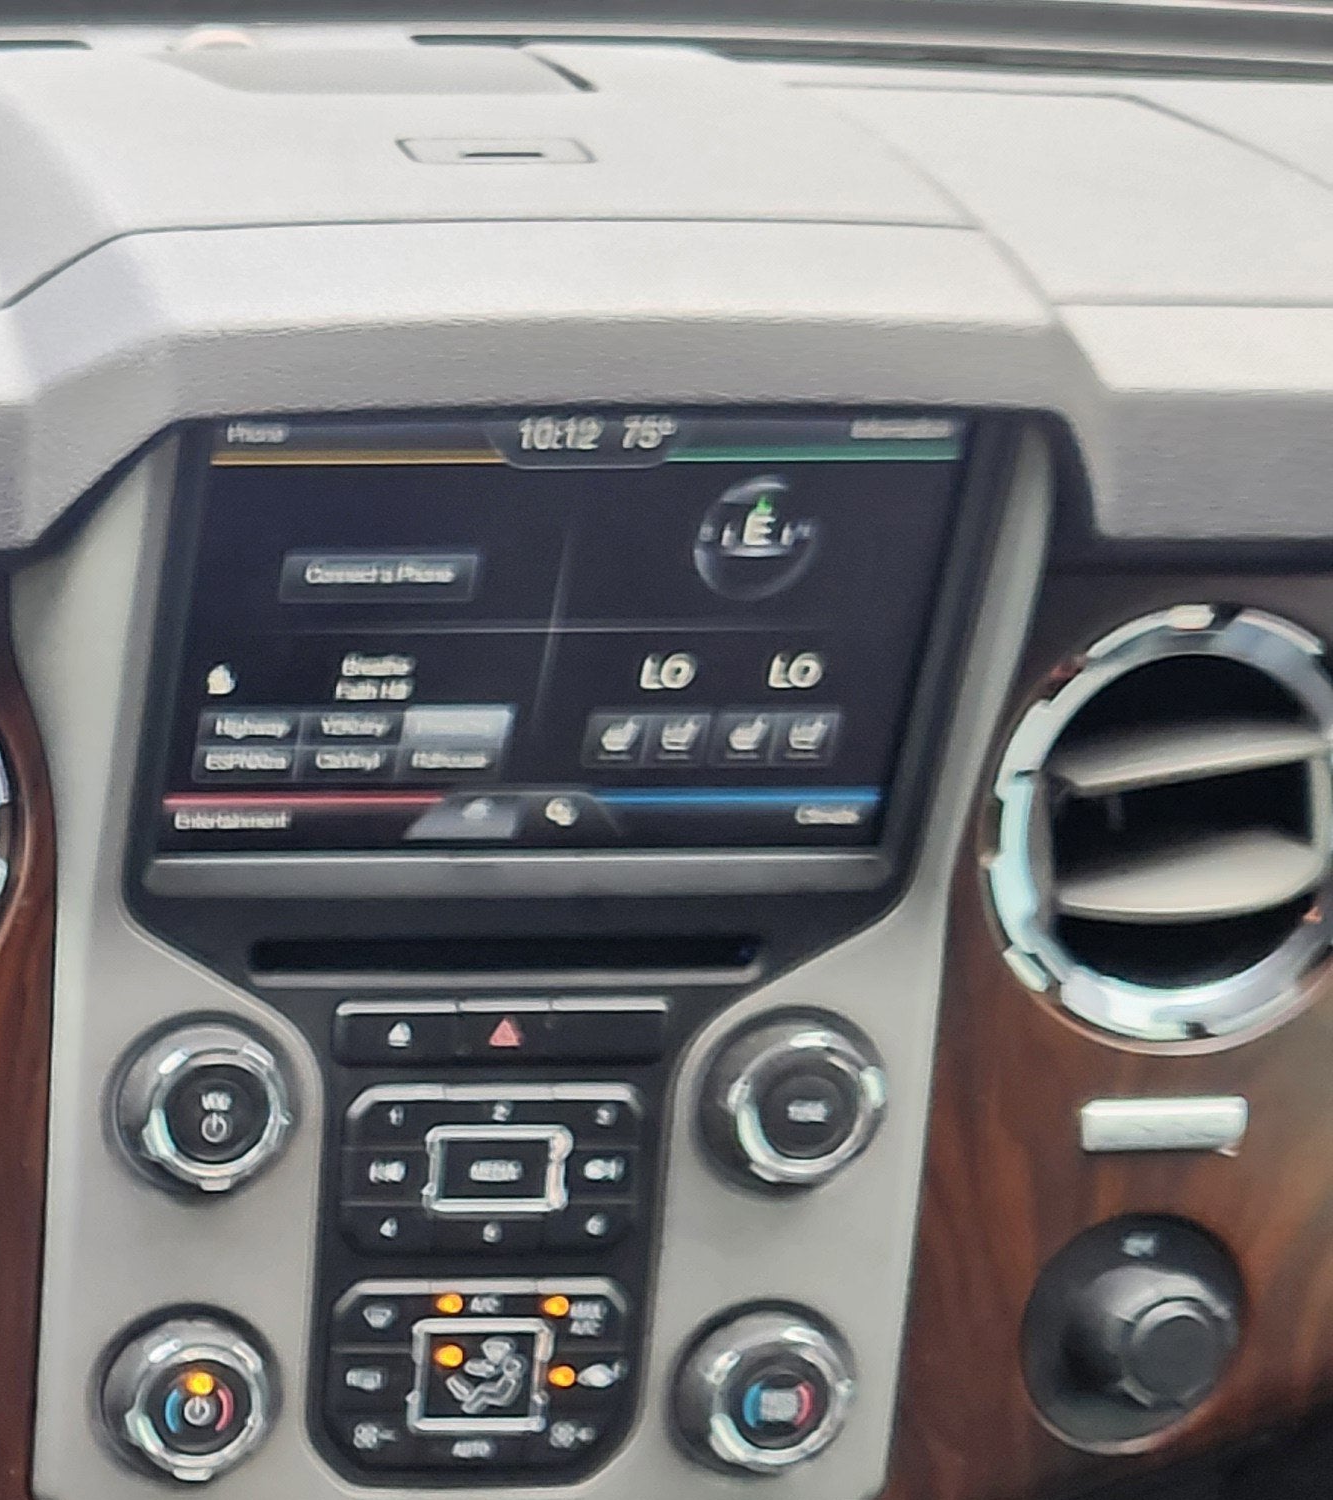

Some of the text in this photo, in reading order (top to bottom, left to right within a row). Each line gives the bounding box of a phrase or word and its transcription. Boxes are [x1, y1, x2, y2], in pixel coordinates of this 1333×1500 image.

[519, 418, 602, 450] 10:12
[640, 653, 696, 690] LO
[768, 652, 823, 688] LO
